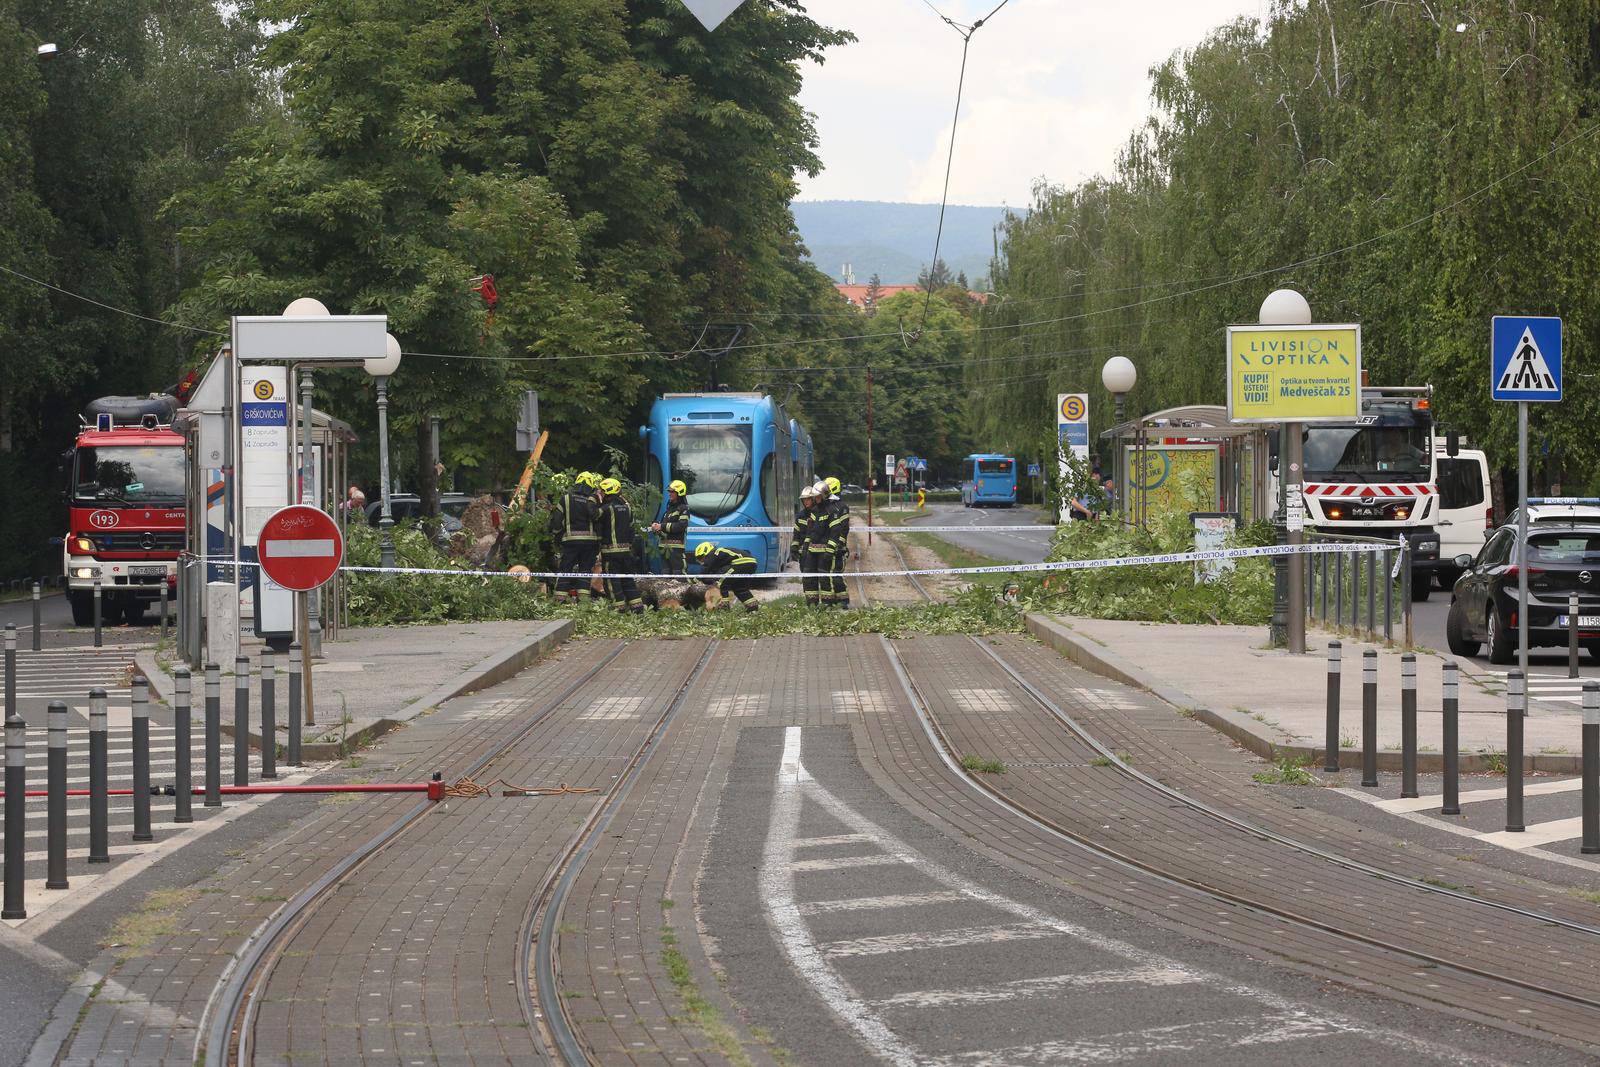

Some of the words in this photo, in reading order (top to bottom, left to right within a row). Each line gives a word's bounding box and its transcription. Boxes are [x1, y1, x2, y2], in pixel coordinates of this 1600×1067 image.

[1251, 338, 1338, 353] LIVISION
[1262, 354, 1330, 365] OPTIKA
[1243, 374, 1269, 384] KUPI!
[1280, 378, 1302, 387] Optika
[259, 384, 269, 396] S
[1280, 386, 1336, 397] Medveščak
[1338, 387, 1350, 396] 25
[1244, 392, 1268, 402] VIDI!
[1067, 401, 1079, 415] S
[1352, 508, 1384, 516] MAN
[96, 515, 114, 525] 193
[1229, 549, 1248, 557] STOP
[1263, 546, 1294, 554] POLICIJA
[1123, 556, 1156, 564] POLICIJA
[1159, 554, 1178, 562] STOP
[1193, 552, 1225, 560] POLICIJA
